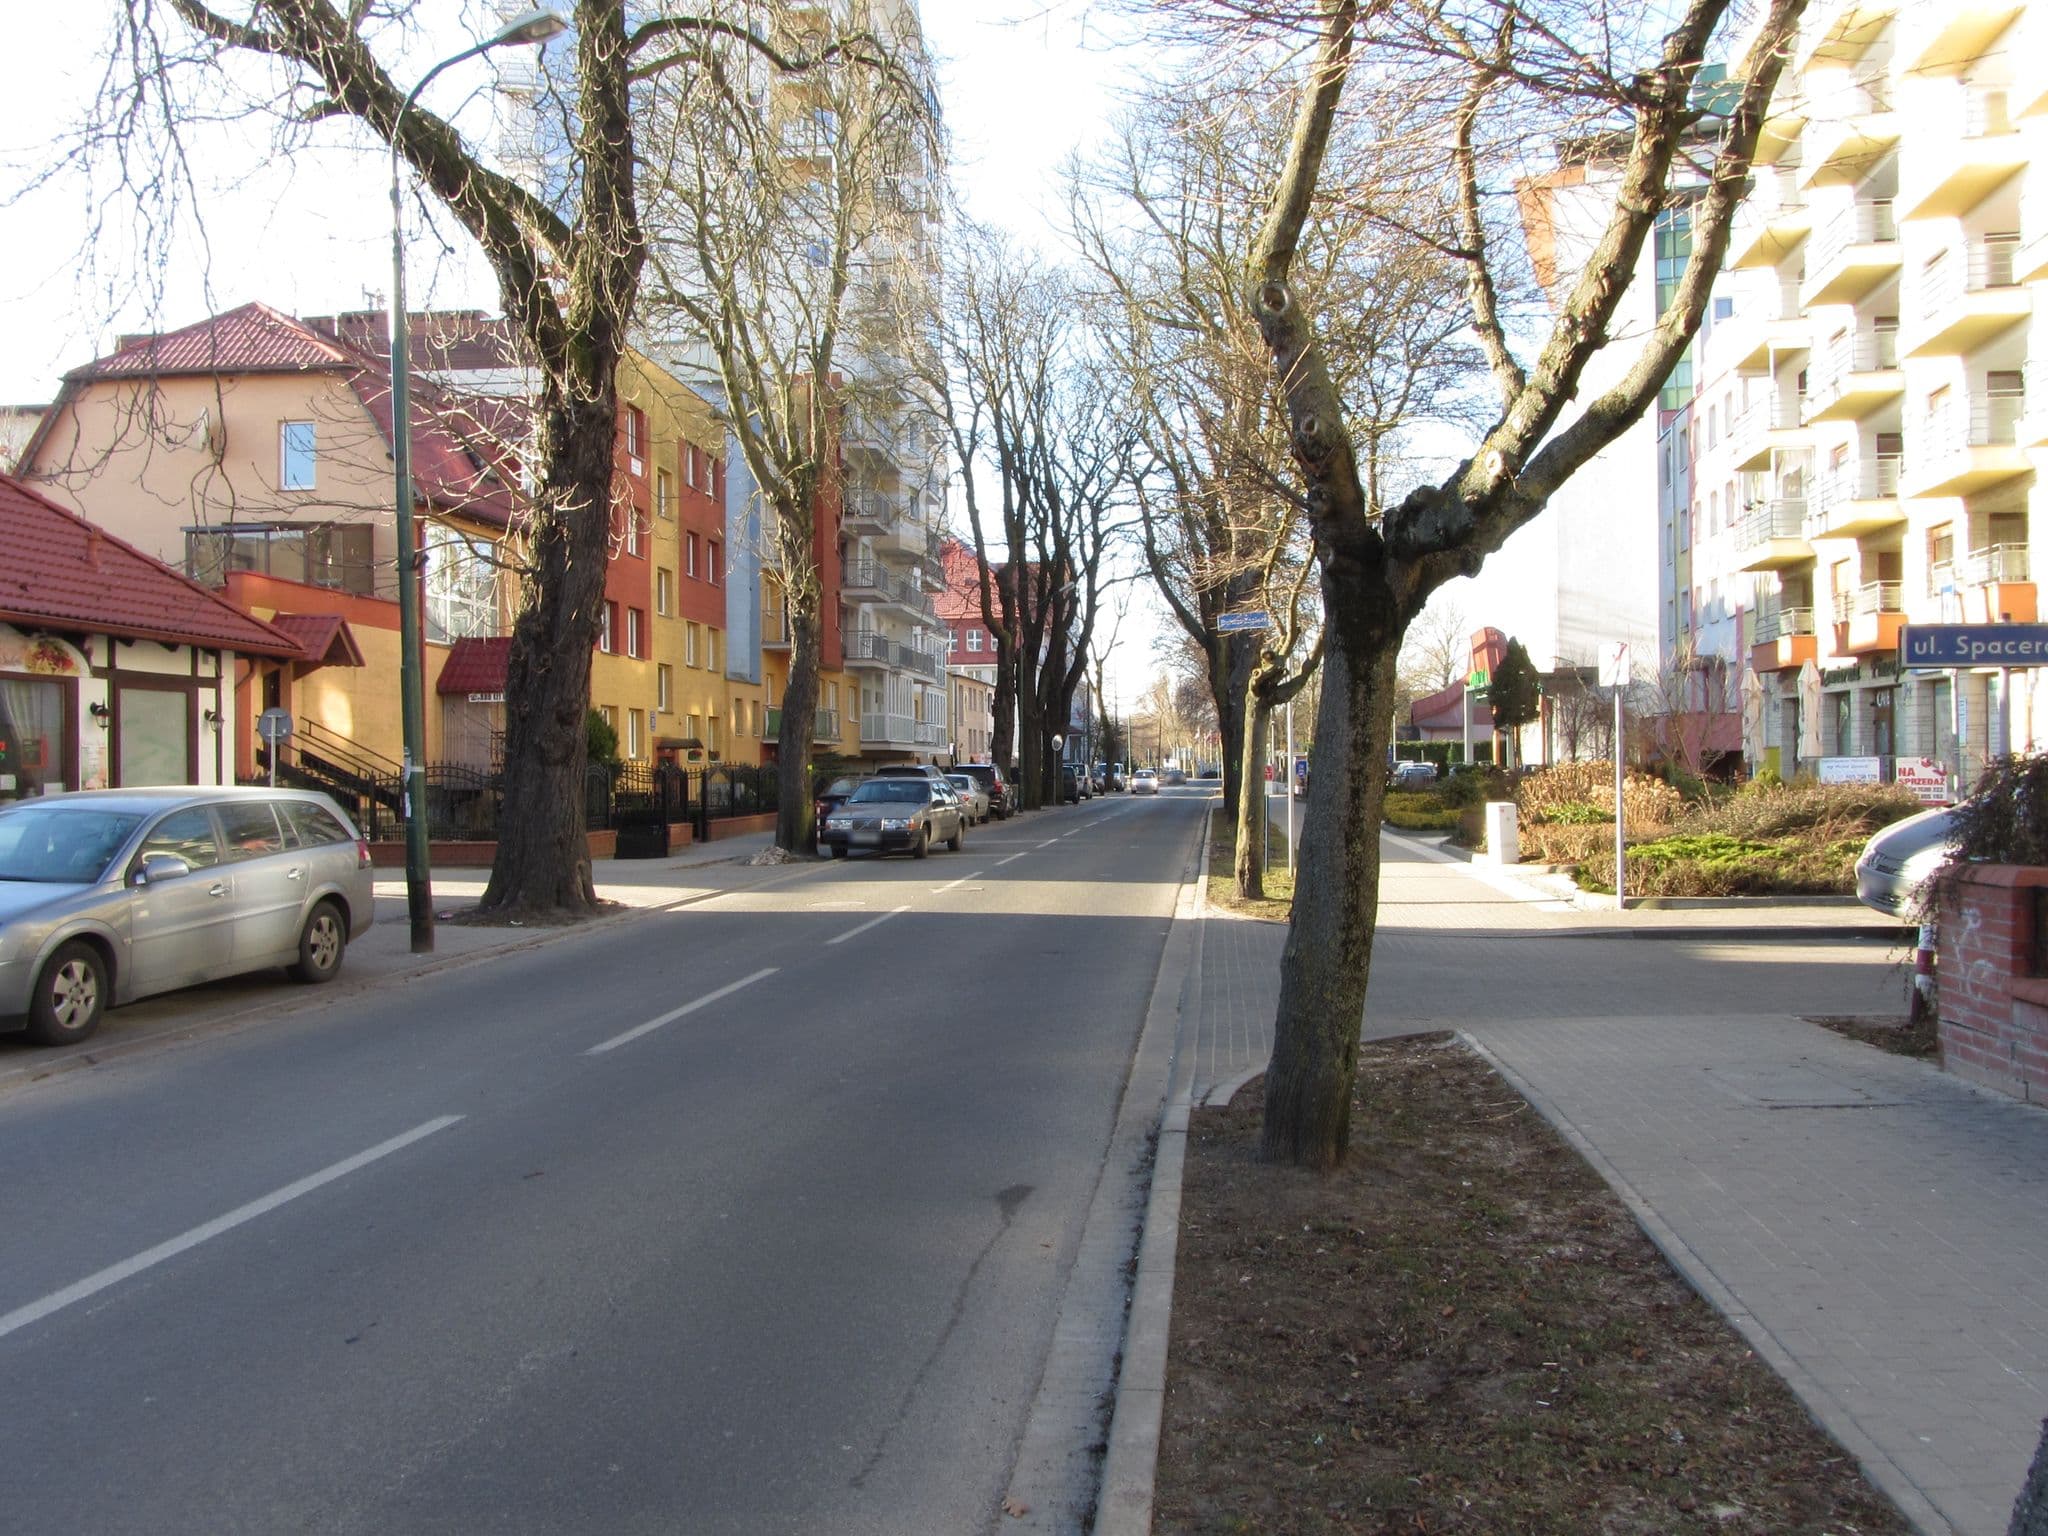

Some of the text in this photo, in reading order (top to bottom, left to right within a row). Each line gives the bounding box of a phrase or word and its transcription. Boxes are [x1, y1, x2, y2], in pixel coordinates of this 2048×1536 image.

[1914, 635, 2048, 660] ul. Spacer
[1898, 767, 1916, 777] NA
